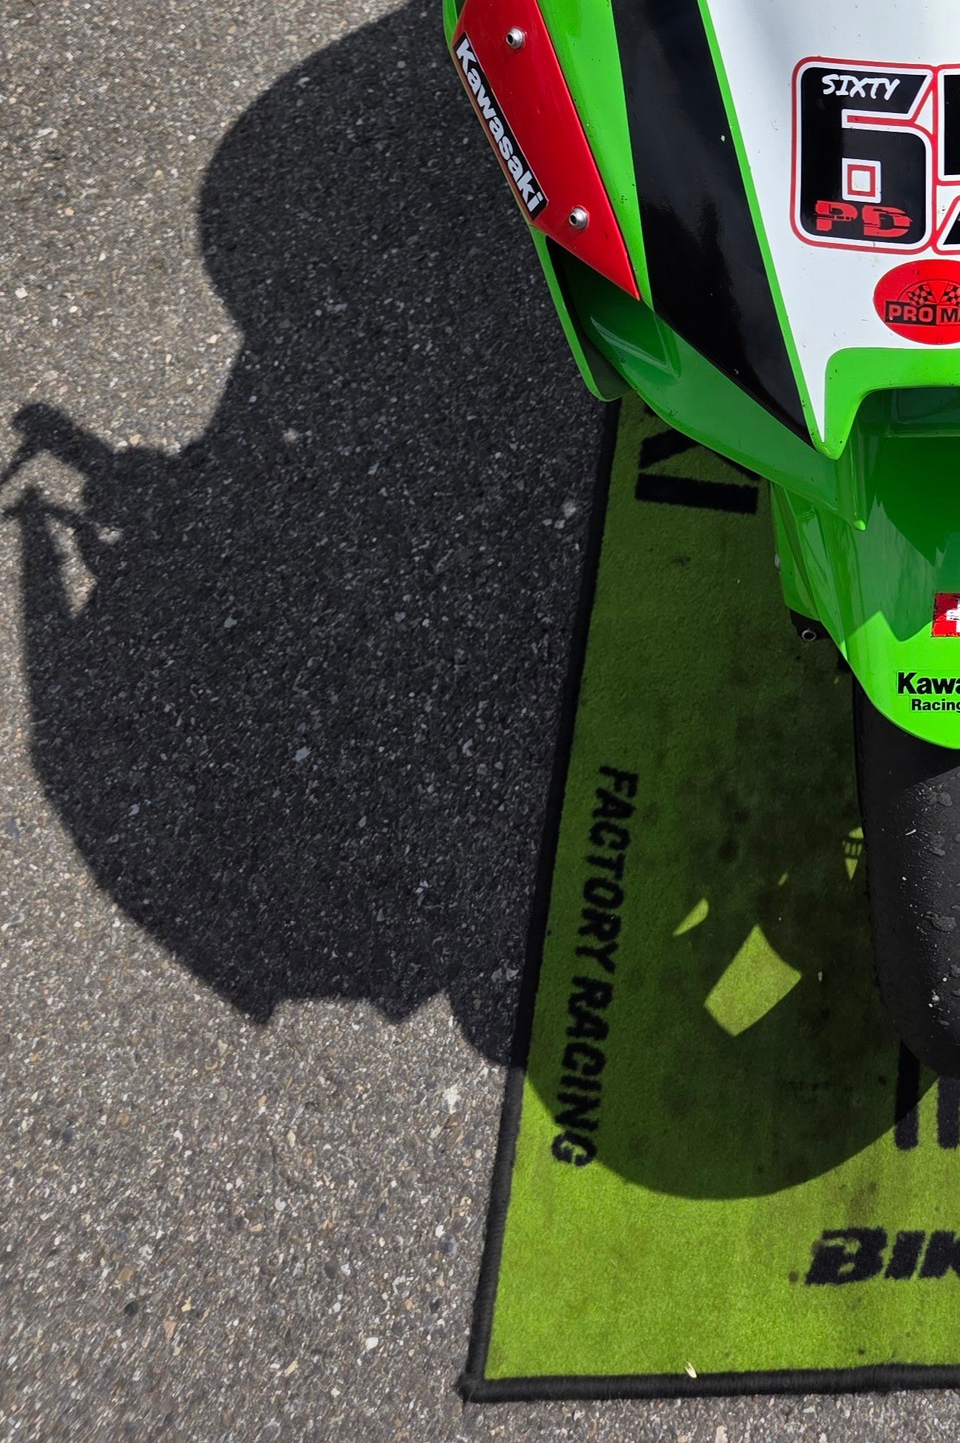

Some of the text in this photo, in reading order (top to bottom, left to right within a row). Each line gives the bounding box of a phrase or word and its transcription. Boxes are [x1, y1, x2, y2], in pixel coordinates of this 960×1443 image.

[456, 38, 545, 213] Kawasaki
[821, 74, 900, 100] SIXTY
[889, 304, 934, 323] PRO
[551, 765, 639, 1167] FACTORY RACING
